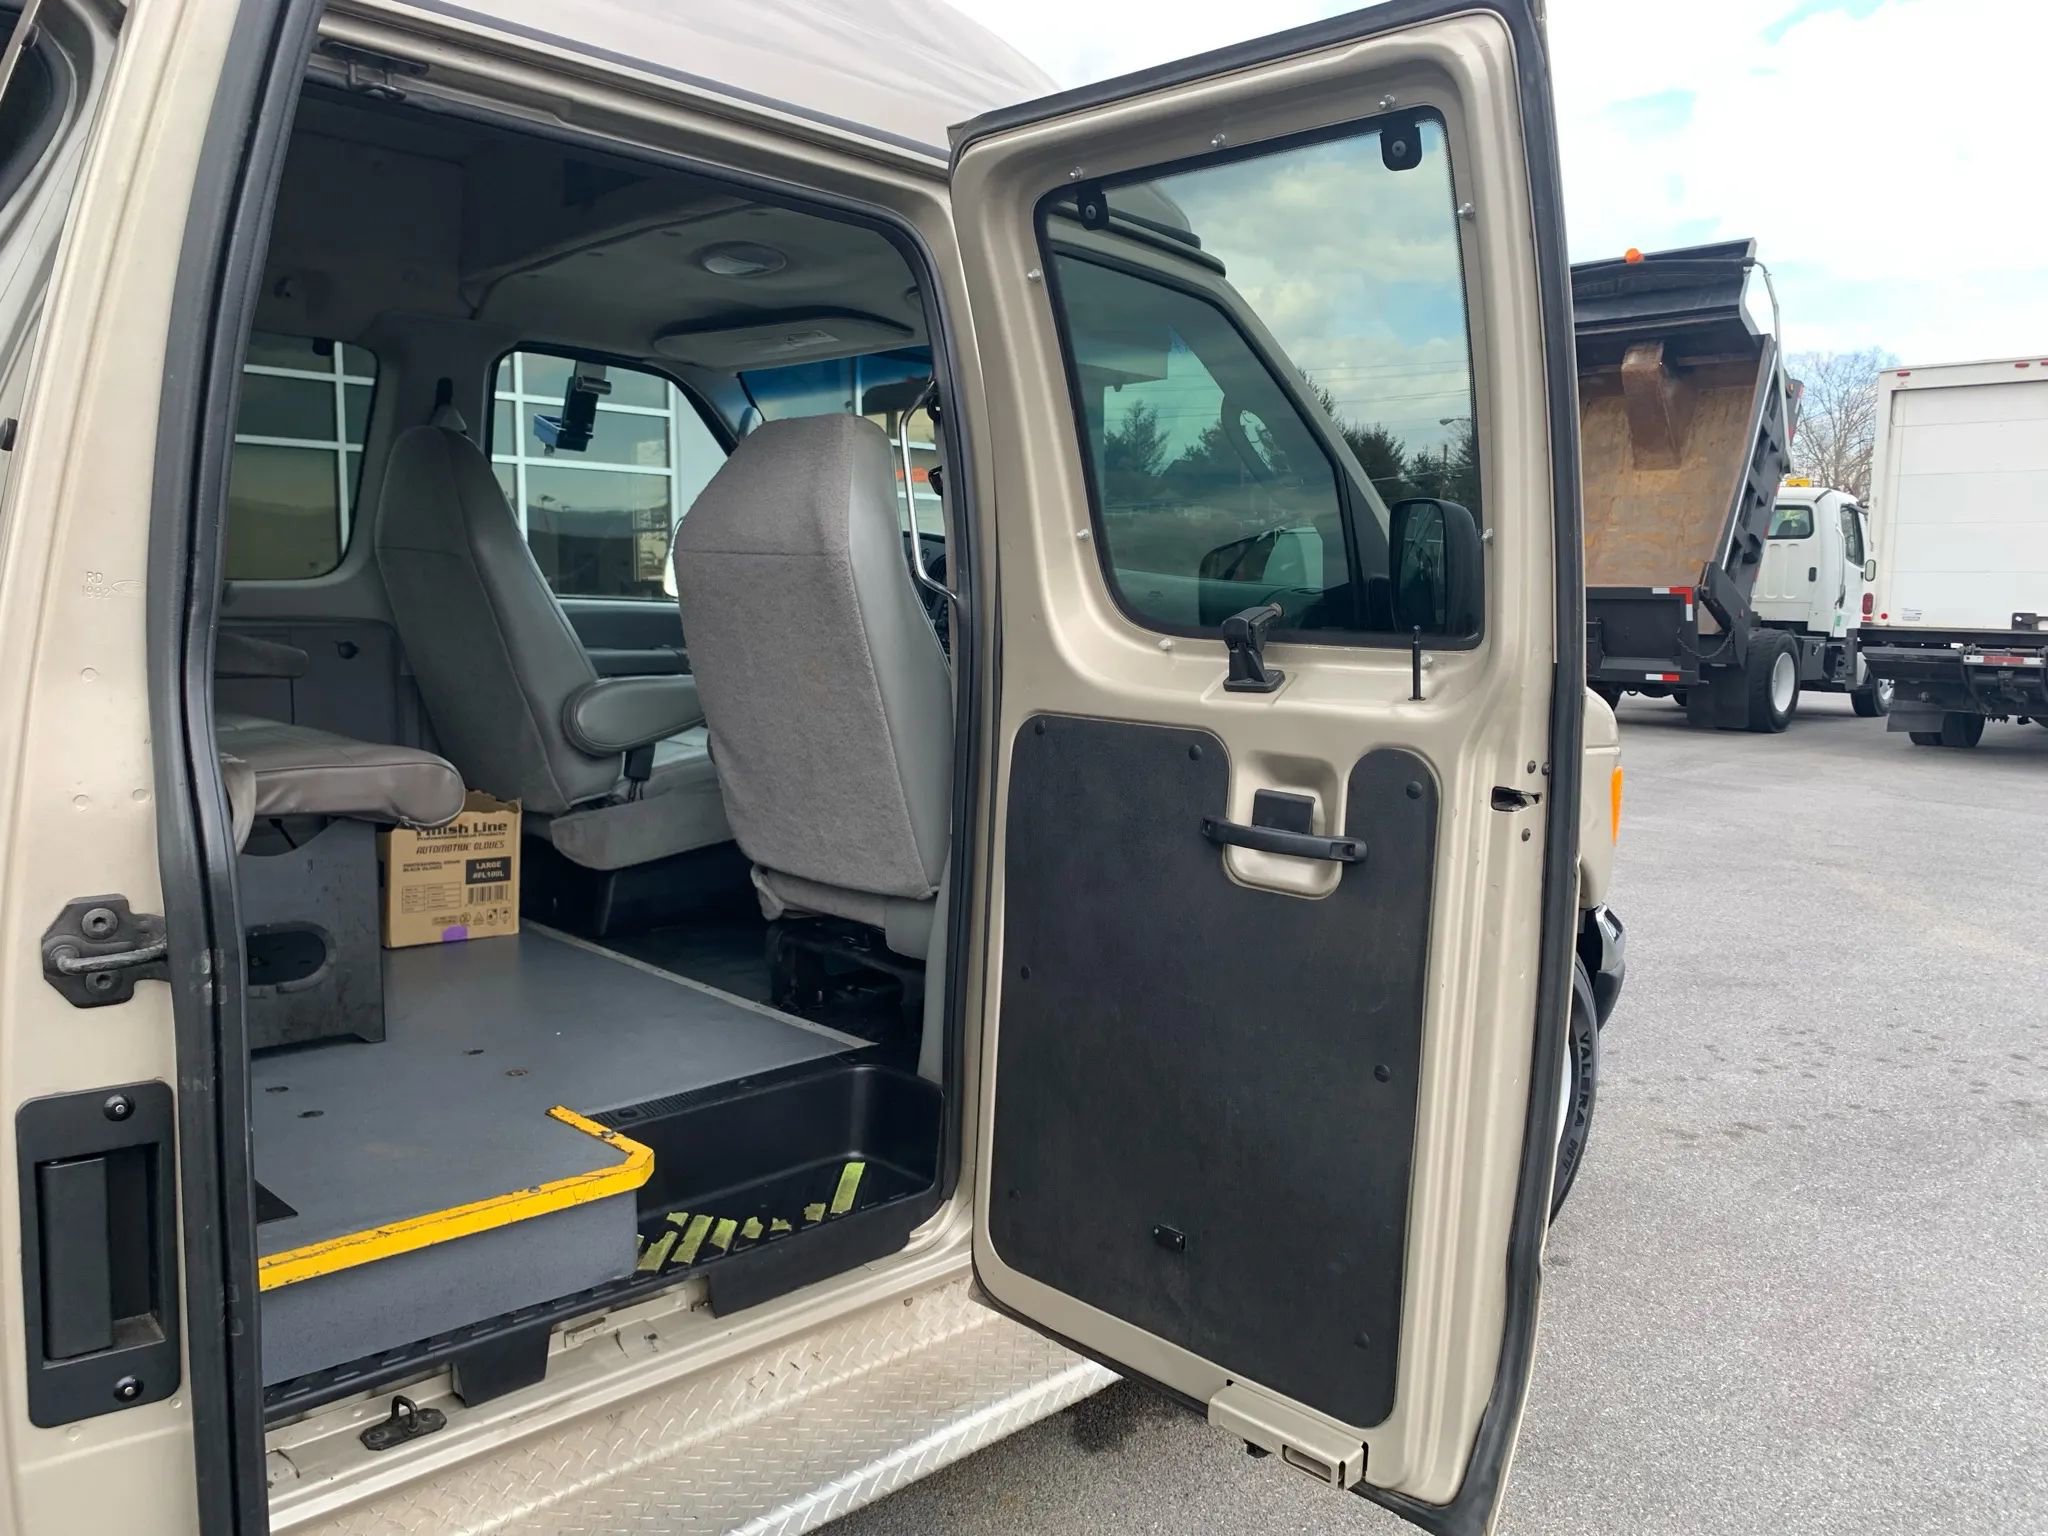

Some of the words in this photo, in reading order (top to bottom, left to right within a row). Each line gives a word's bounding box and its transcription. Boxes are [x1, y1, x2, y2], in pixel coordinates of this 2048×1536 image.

[87, 571, 103, 584] RD
[473, 822, 507, 832] Line
[474, 840, 505, 850] GLOVES
[476, 861, 502, 869] LARGE
[1575, 1031, 1591, 1127] VALERA
